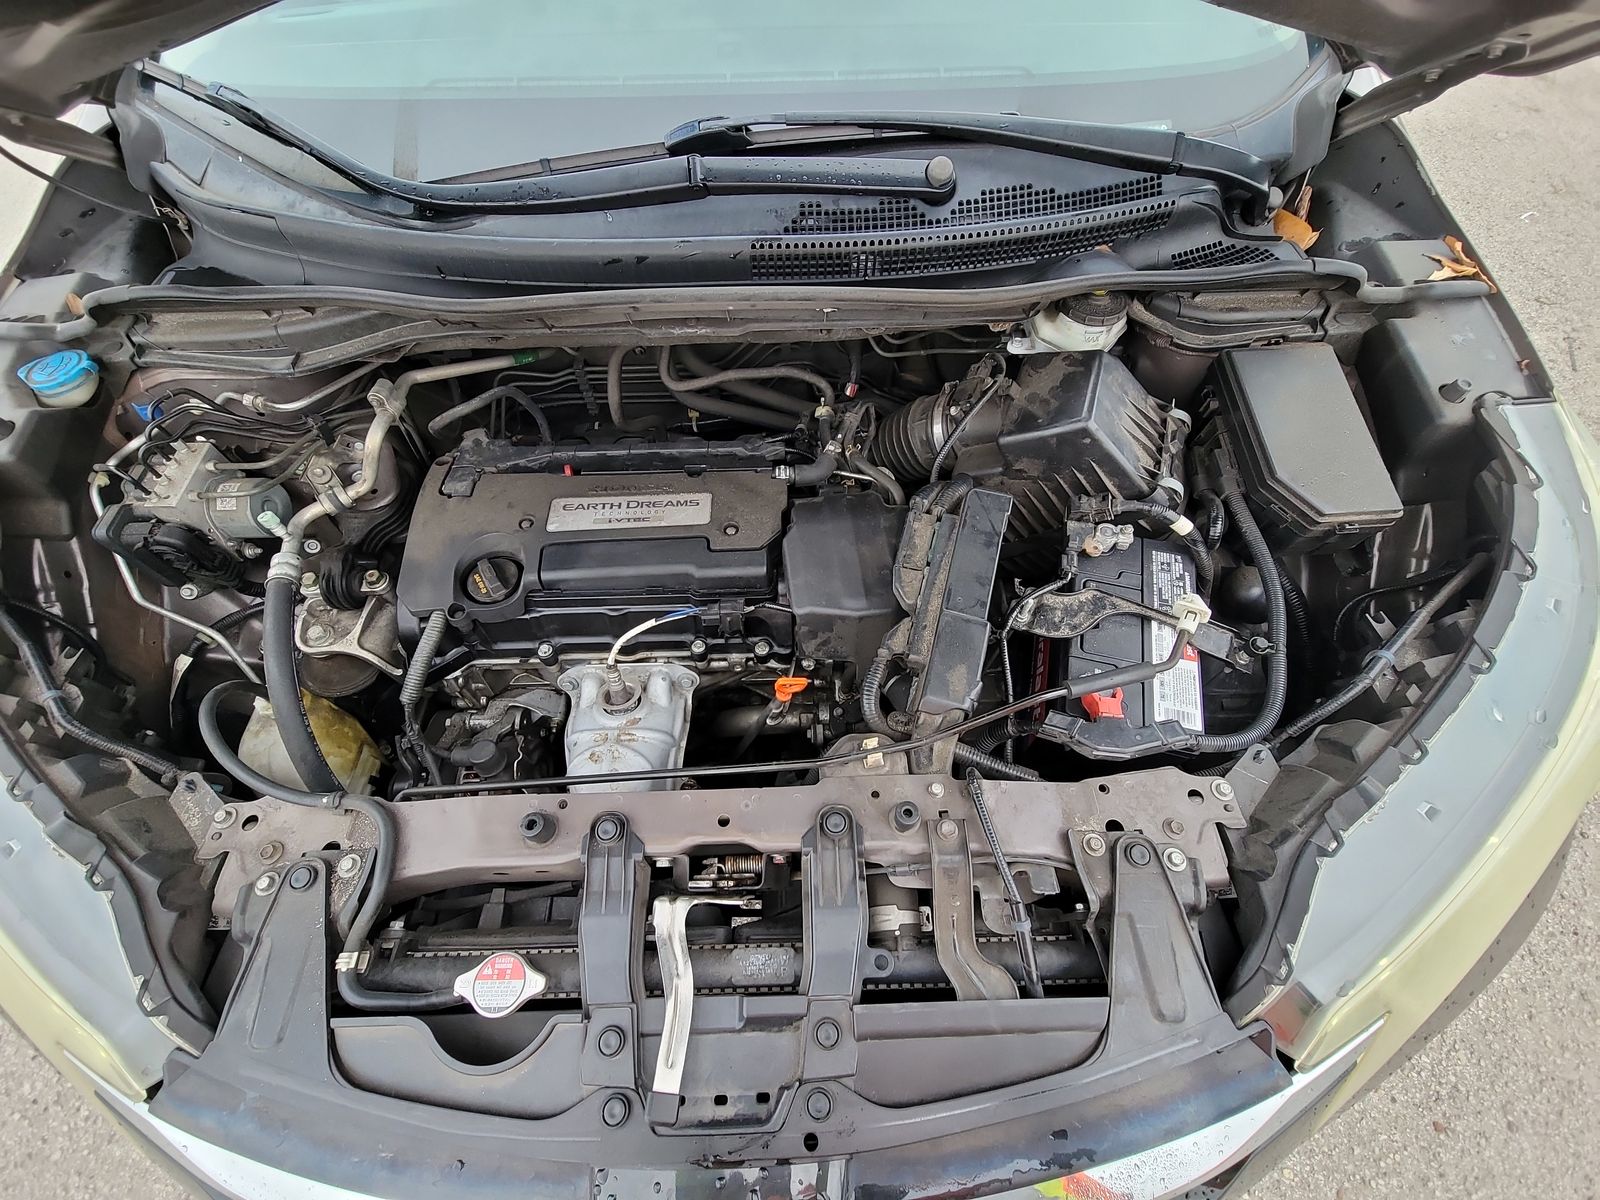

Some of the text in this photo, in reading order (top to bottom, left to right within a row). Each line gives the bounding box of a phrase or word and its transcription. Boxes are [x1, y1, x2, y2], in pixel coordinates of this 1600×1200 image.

[562, 499, 700, 511] EARTH DREAMS
[593, 509, 666, 517] TECHNOLOGY
